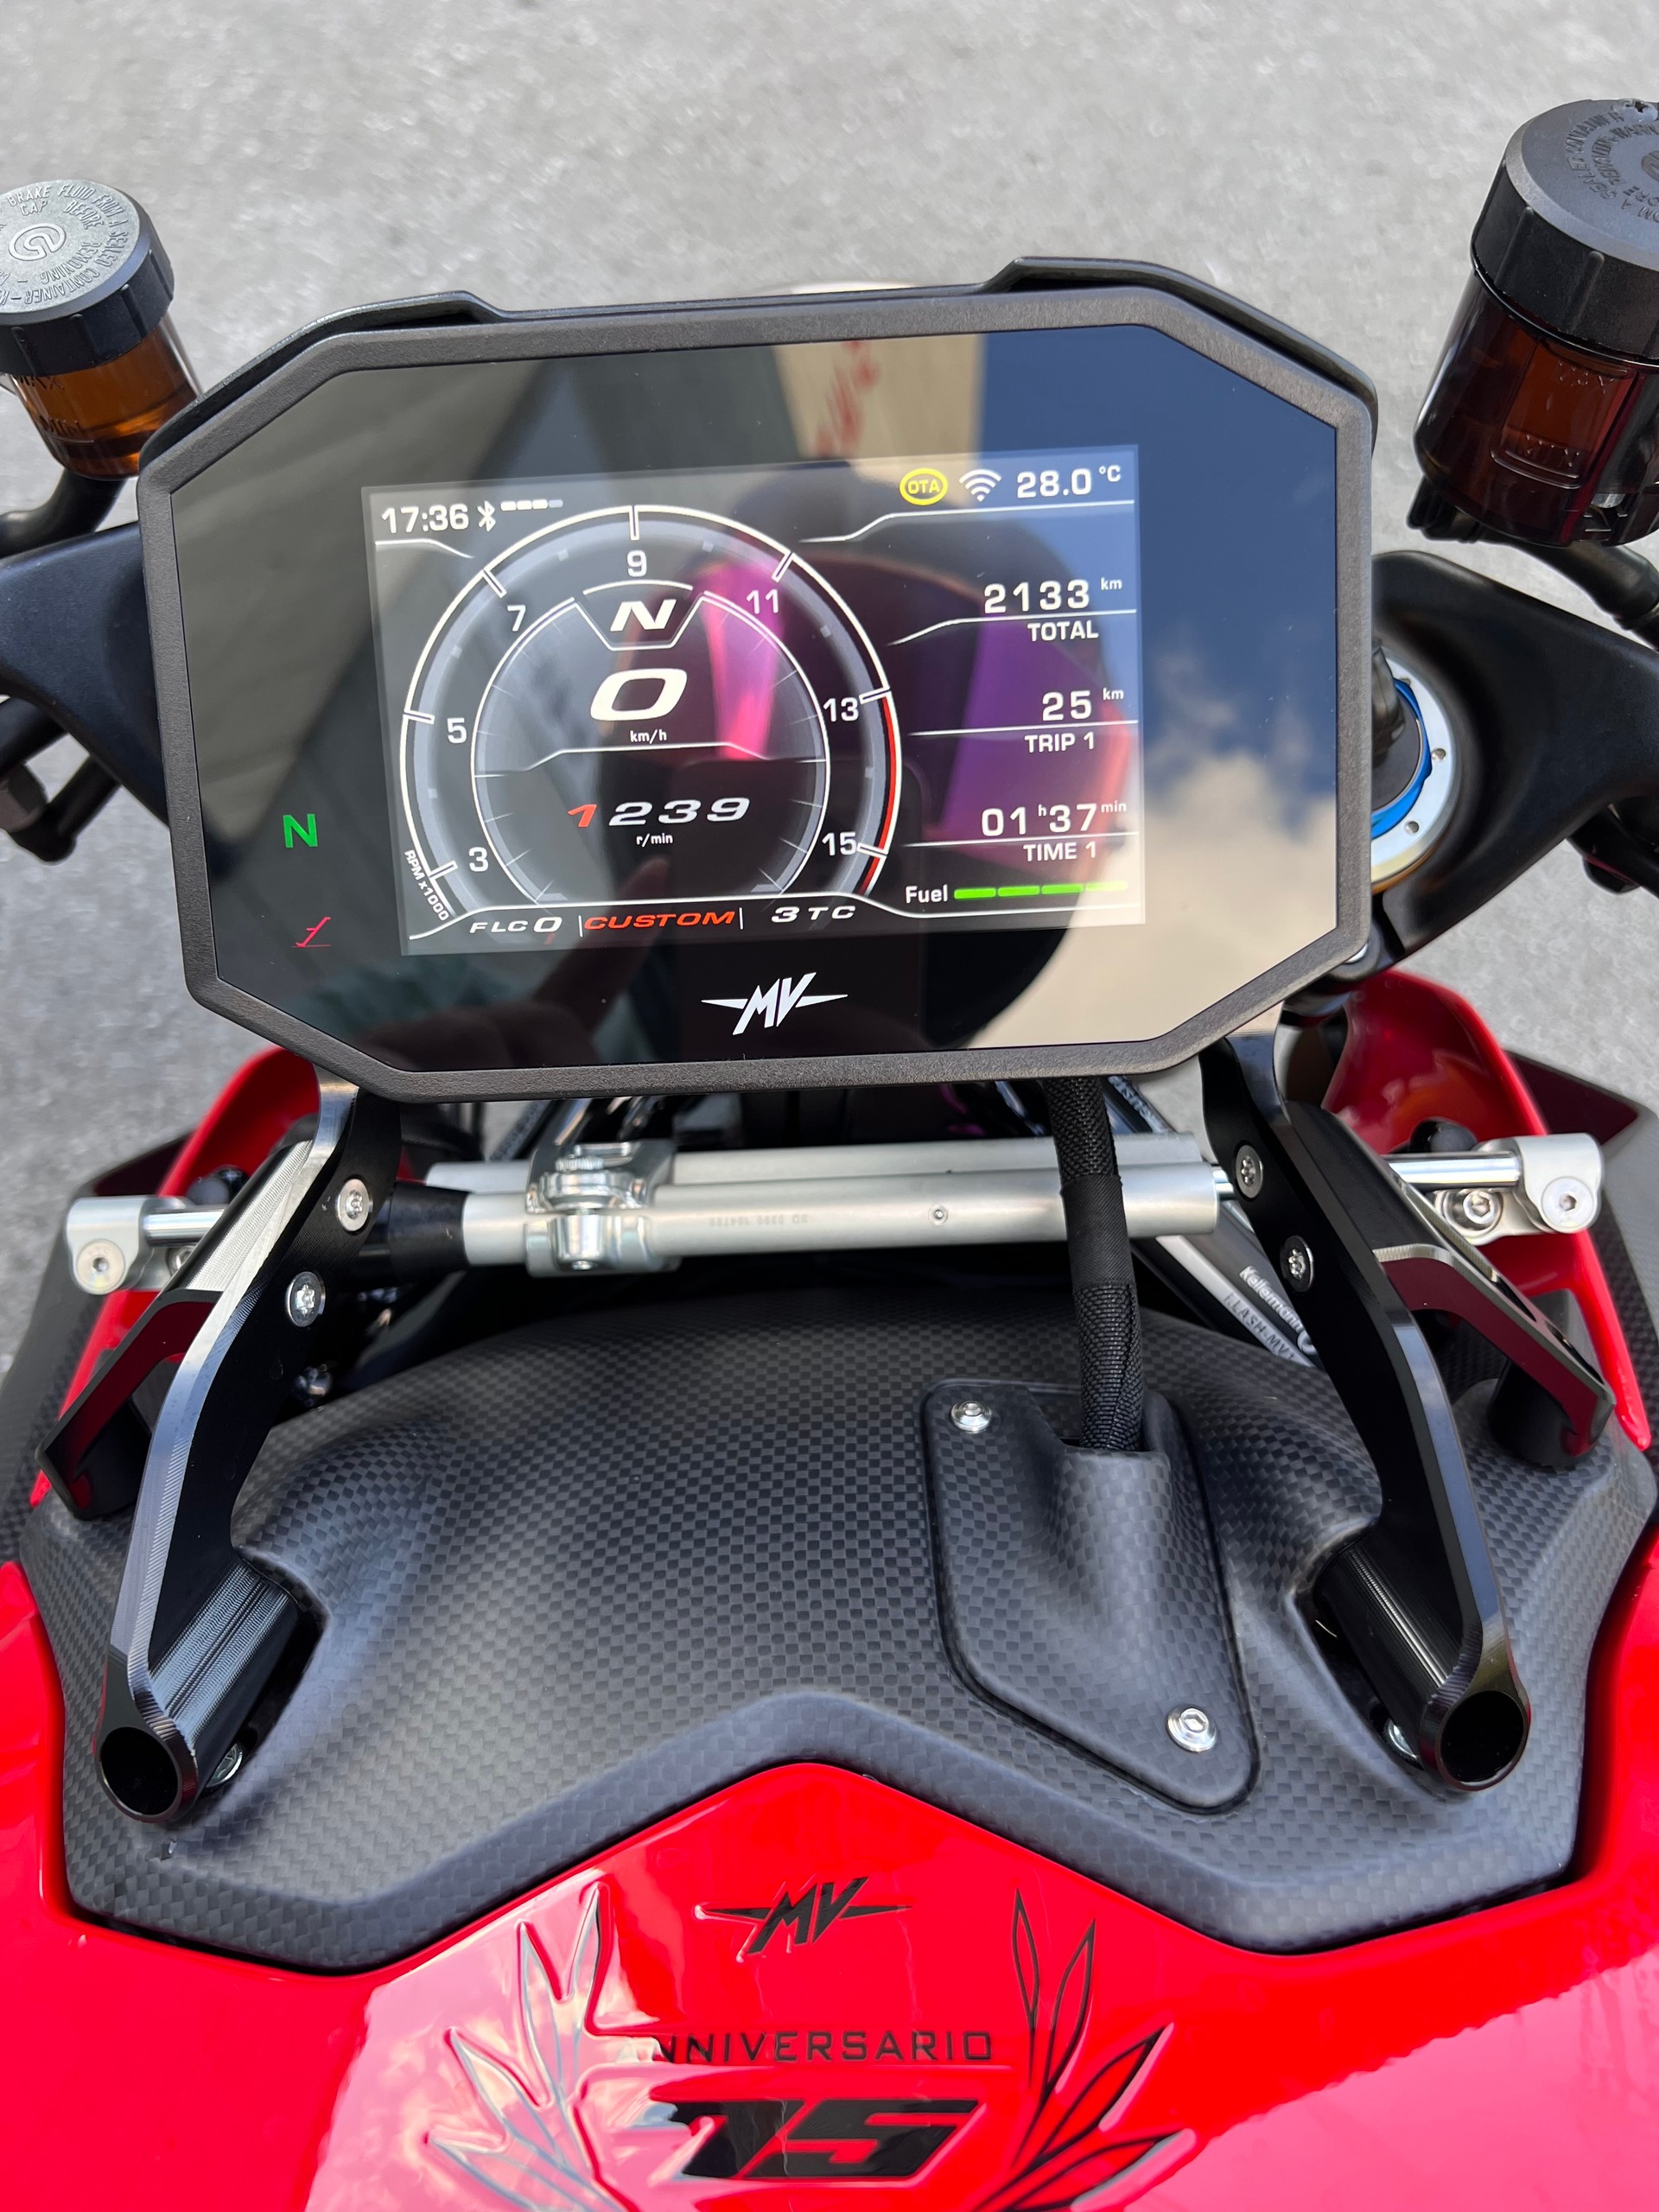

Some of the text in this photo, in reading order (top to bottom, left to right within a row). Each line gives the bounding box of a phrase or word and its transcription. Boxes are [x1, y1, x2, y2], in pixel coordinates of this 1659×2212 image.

[7, 184, 130, 306] BRAKE FLUID FROM A SEALED CONTAINER
[20, 198, 105, 285] CAP BEFORE REMOVING
[907, 479, 941, 495] OTA
[1016, 465, 1122, 499] 28.0 °C
[381, 503, 469, 533] 17:36
[626, 550, 647, 577] 9
[747, 589, 779, 614] 11
[983, 577, 1123, 614] 2133 km
[507, 605, 526, 632] 7
[610, 599, 677, 632] N
[1027, 620, 1099, 642] TOTAL
[590, 668, 687, 721] 0
[1042, 687, 1125, 721] 25 km
[823, 696, 860, 722] 13
[447, 718, 467, 743] 5
[630, 728, 667, 744] km/h
[1025, 732, 1096, 753] TRIP 1
[568, 797, 750, 828] 1239
[1101, 800, 1128, 814] min
[283, 813, 318, 849] N
[636, 831, 673, 847] r/min
[822, 832, 859, 857] 15
[468, 847, 489, 873] 3
[1024, 841, 1096, 862] TIME 1
[404, 849, 450, 922] RPM x1000
[906, 885, 949, 904] Fuel
[583, 911, 735, 930] CUSTOM
[731, 972, 817, 1035] MV
[1239, 1266, 1304, 1332] Kellermann
[745, 1877, 869, 1955] MV
[652, 2031, 994, 2064] NNIVERSARIO
[669, 2098, 979, 2179] 15
